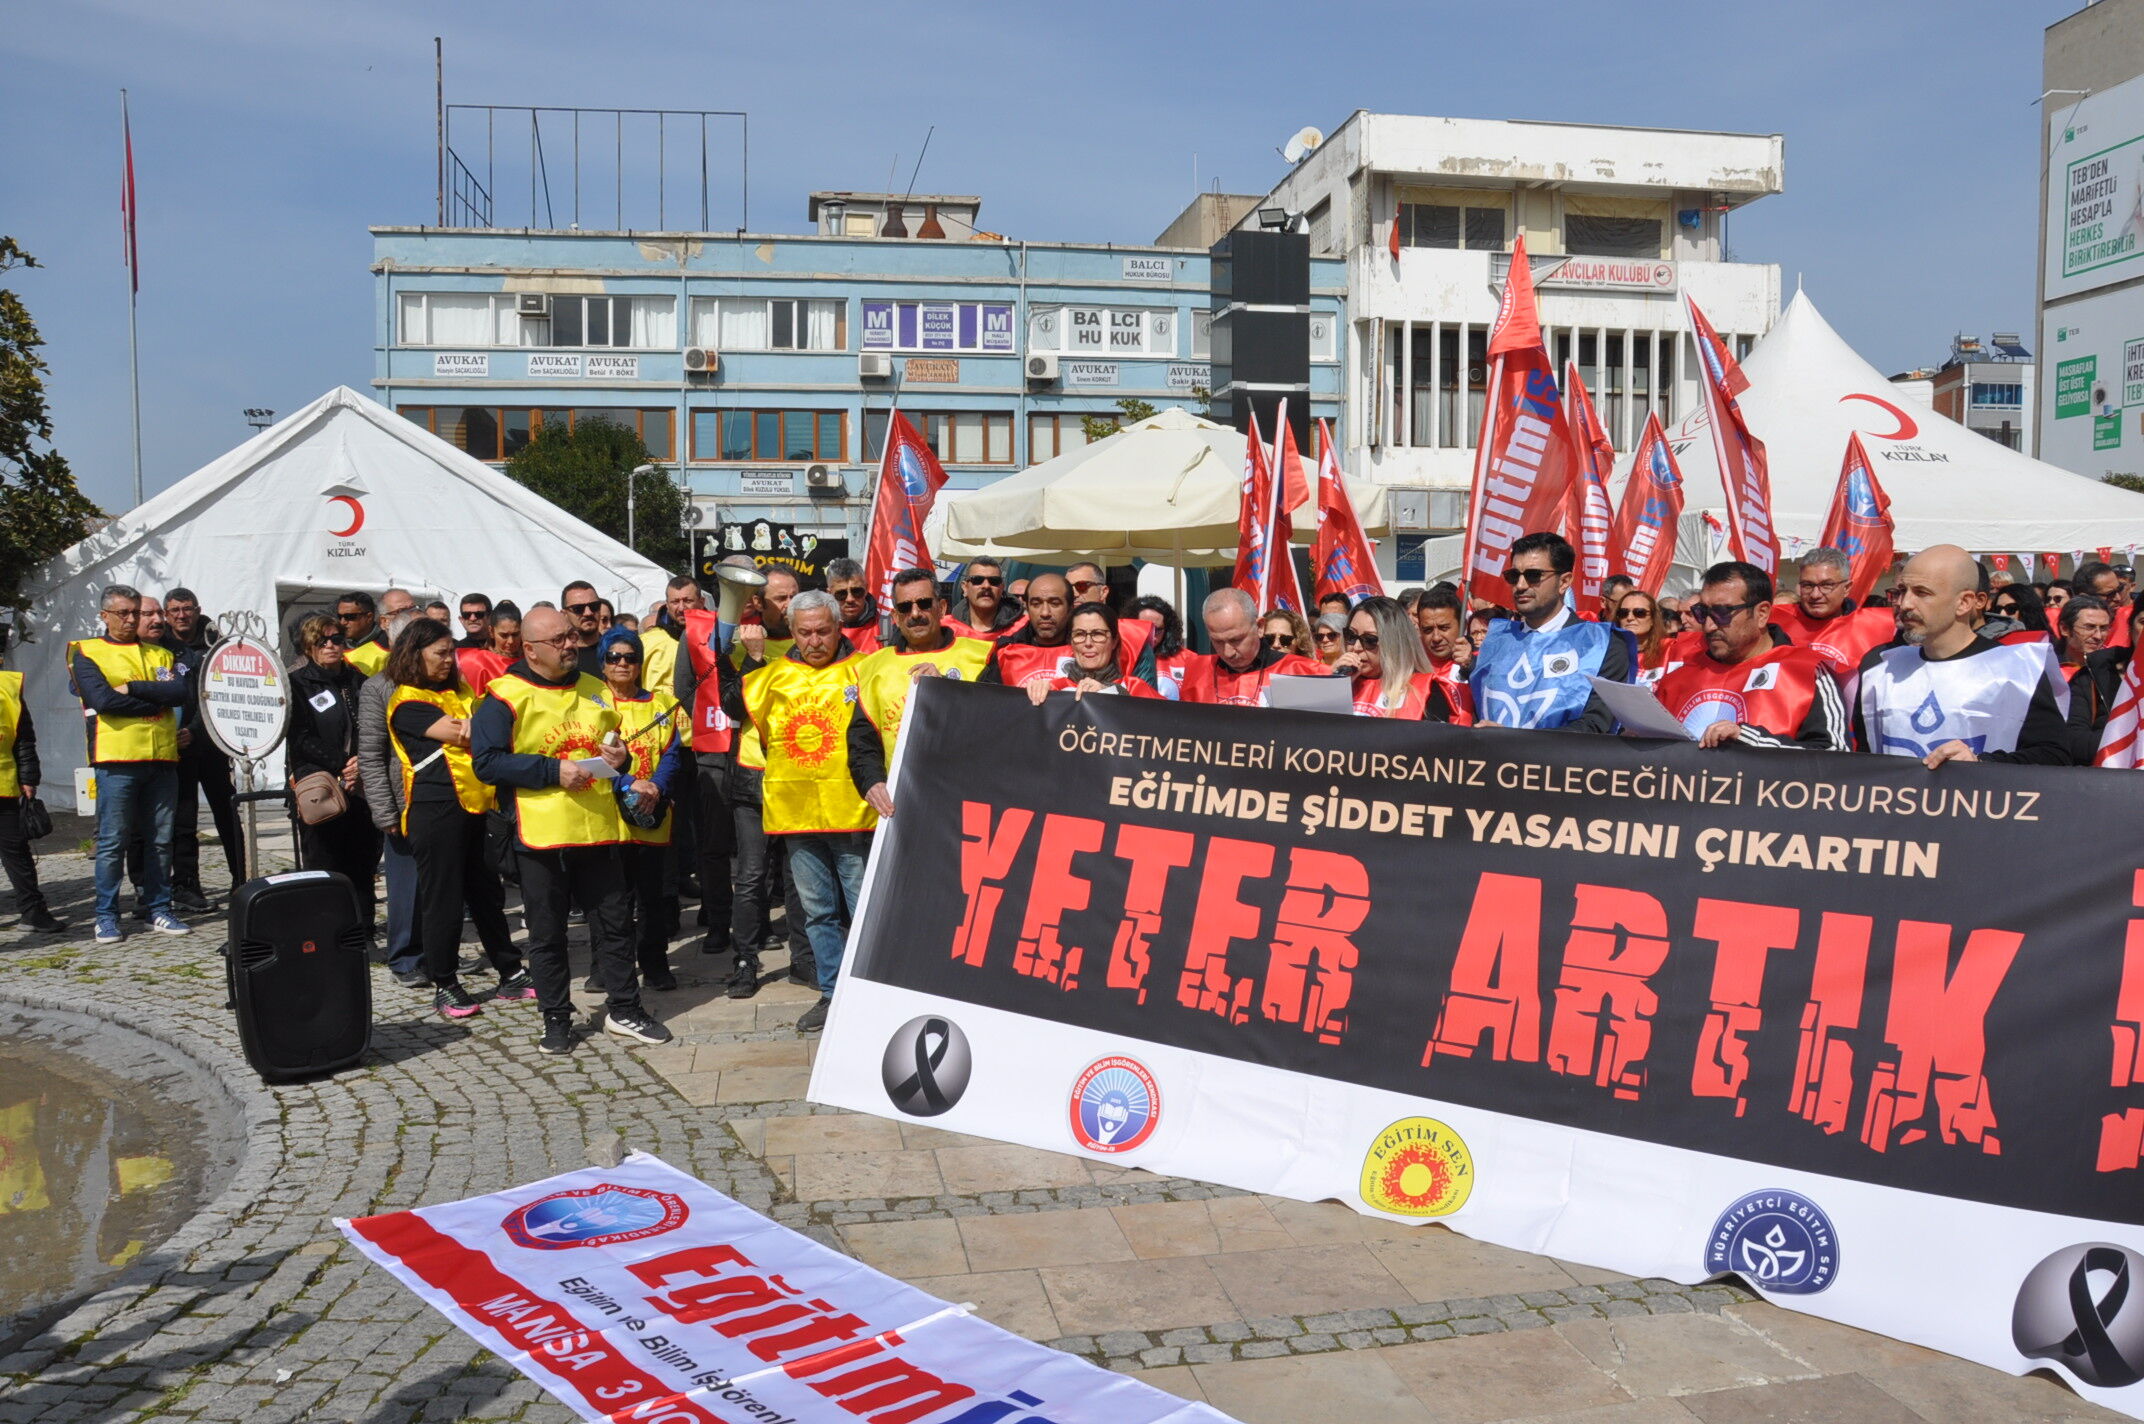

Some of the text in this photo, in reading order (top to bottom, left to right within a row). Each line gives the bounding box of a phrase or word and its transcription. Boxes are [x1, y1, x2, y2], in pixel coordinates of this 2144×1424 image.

[2076, 125, 2088, 135] TEB
[2069, 222, 2103, 248] HERKES
[1130, 260, 1165, 270] BALCI
[1562, 262, 1605, 280] AVCILAR
[1608, 262, 1651, 282] KULÜBÜ
[925, 321, 952, 331] KÜÇÜK
[927, 312, 949, 320] DİLEK
[437, 356, 487, 365] AVUKAT
[530, 356, 580, 366] AVUKAT
[588, 357, 637, 367] AVUKAT
[1071, 365, 1117, 374] AVUKAT
[1881, 452, 1950, 463] KIZILAY
[327, 548, 366, 557] KIZILAY
[223, 650, 256, 673] DİKKAT
[1059, 724, 2041, 822] ÖĞRETMENLERİ KORURSANIZ GELECEĞİNİZİ KORURSUNUZ
[1109, 772, 1941, 879] EĞİTİMDE ŞİDDET YASASINI ÇIKARTIN
[951, 800, 1371, 1045] YETER
[1421, 872, 2026, 1155] ARTIK
[1373, 1124, 1469, 1177] EĞİTİM SEN
[1714, 1196, 1782, 1261] HÜRRİYETÇİ
[1789, 1202, 1829, 1248] EĞİTİM
[1812, 1255, 1830, 1285] SEN
[558, 1276, 623, 1316] Eğitim
[639, 1334, 699, 1373] Bilim
[625, 1243, 976, 1424] Eğitim
[475, 1292, 609, 1371] MANİSA
[595, 1379, 643, 1399] 3
